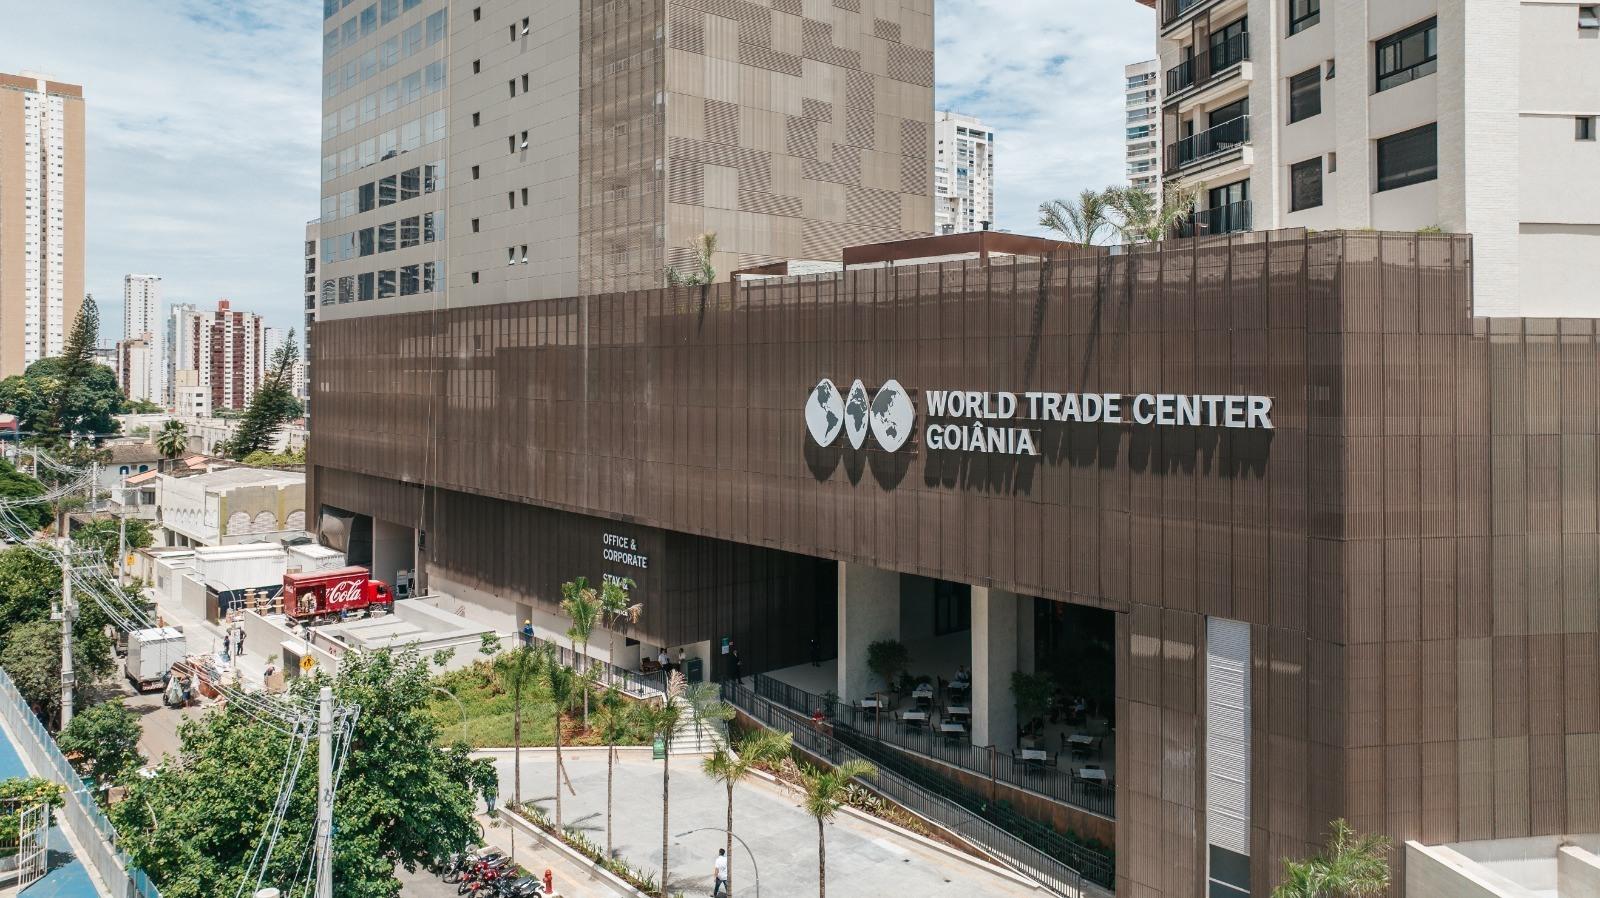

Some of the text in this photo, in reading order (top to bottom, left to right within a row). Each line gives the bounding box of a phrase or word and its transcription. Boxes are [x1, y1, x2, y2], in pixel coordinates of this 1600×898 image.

[926, 390, 1275, 429] WORLD TRADE CENTER
[926, 420, 1037, 456] GOIÂNIA
[603, 533, 637, 551] OFFICE &
[603, 549, 648, 569] CORPORATE
[603, 573, 621, 587] STAY
